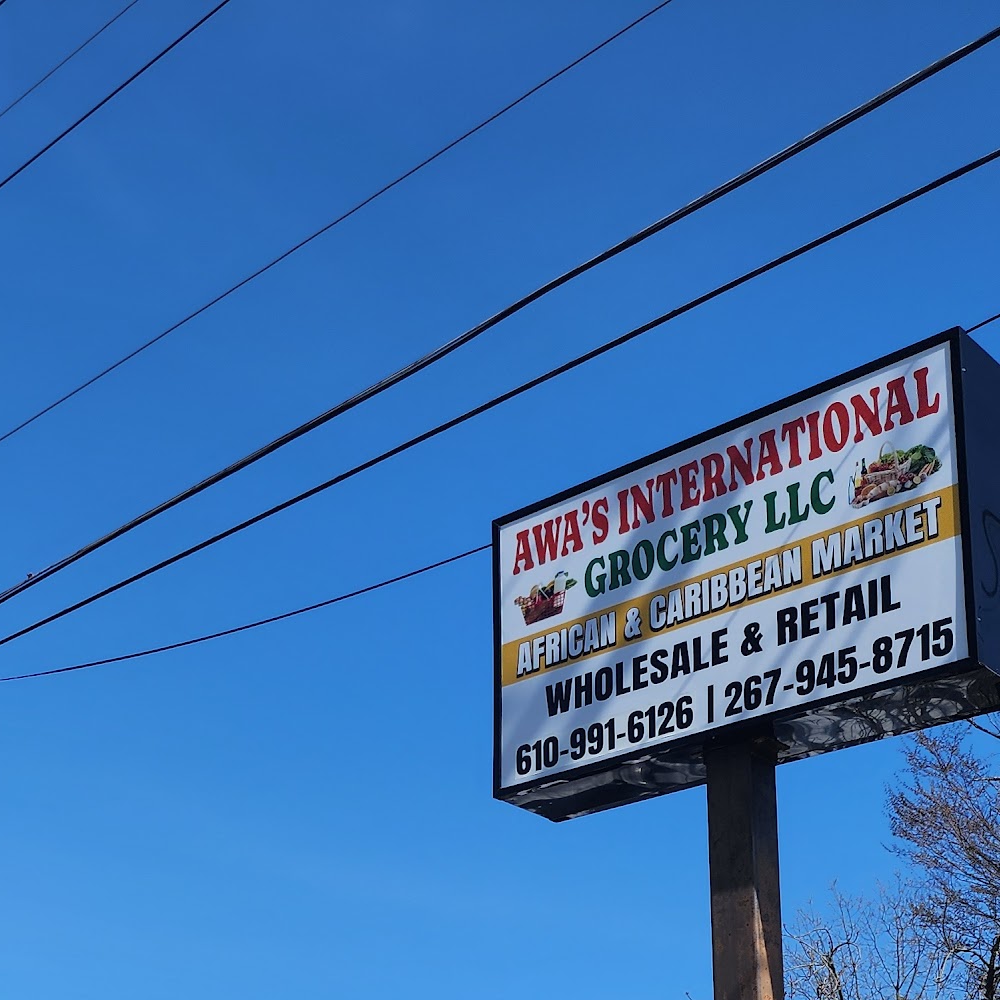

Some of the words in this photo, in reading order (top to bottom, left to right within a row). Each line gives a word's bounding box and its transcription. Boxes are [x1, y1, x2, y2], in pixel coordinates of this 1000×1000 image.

[512, 499, 609, 575] AWA'S
[618, 366, 940, 535] INTERNATIONAL
[584, 501, 752, 599] GROCERY
[765, 469, 836, 534] LLC
[516, 612, 617, 678] AFRICAN
[625, 607, 642, 639] &
[649, 547, 802, 630] CARIBBEAN
[812, 497, 943, 579] MARKET
[546, 628, 728, 717] WHOLESALE
[741, 622, 763, 656] &
[777, 575, 900, 646] RETAIL
[516, 695, 694, 775] 610-991-6126
[725, 617, 954, 717] 267-945-8715
